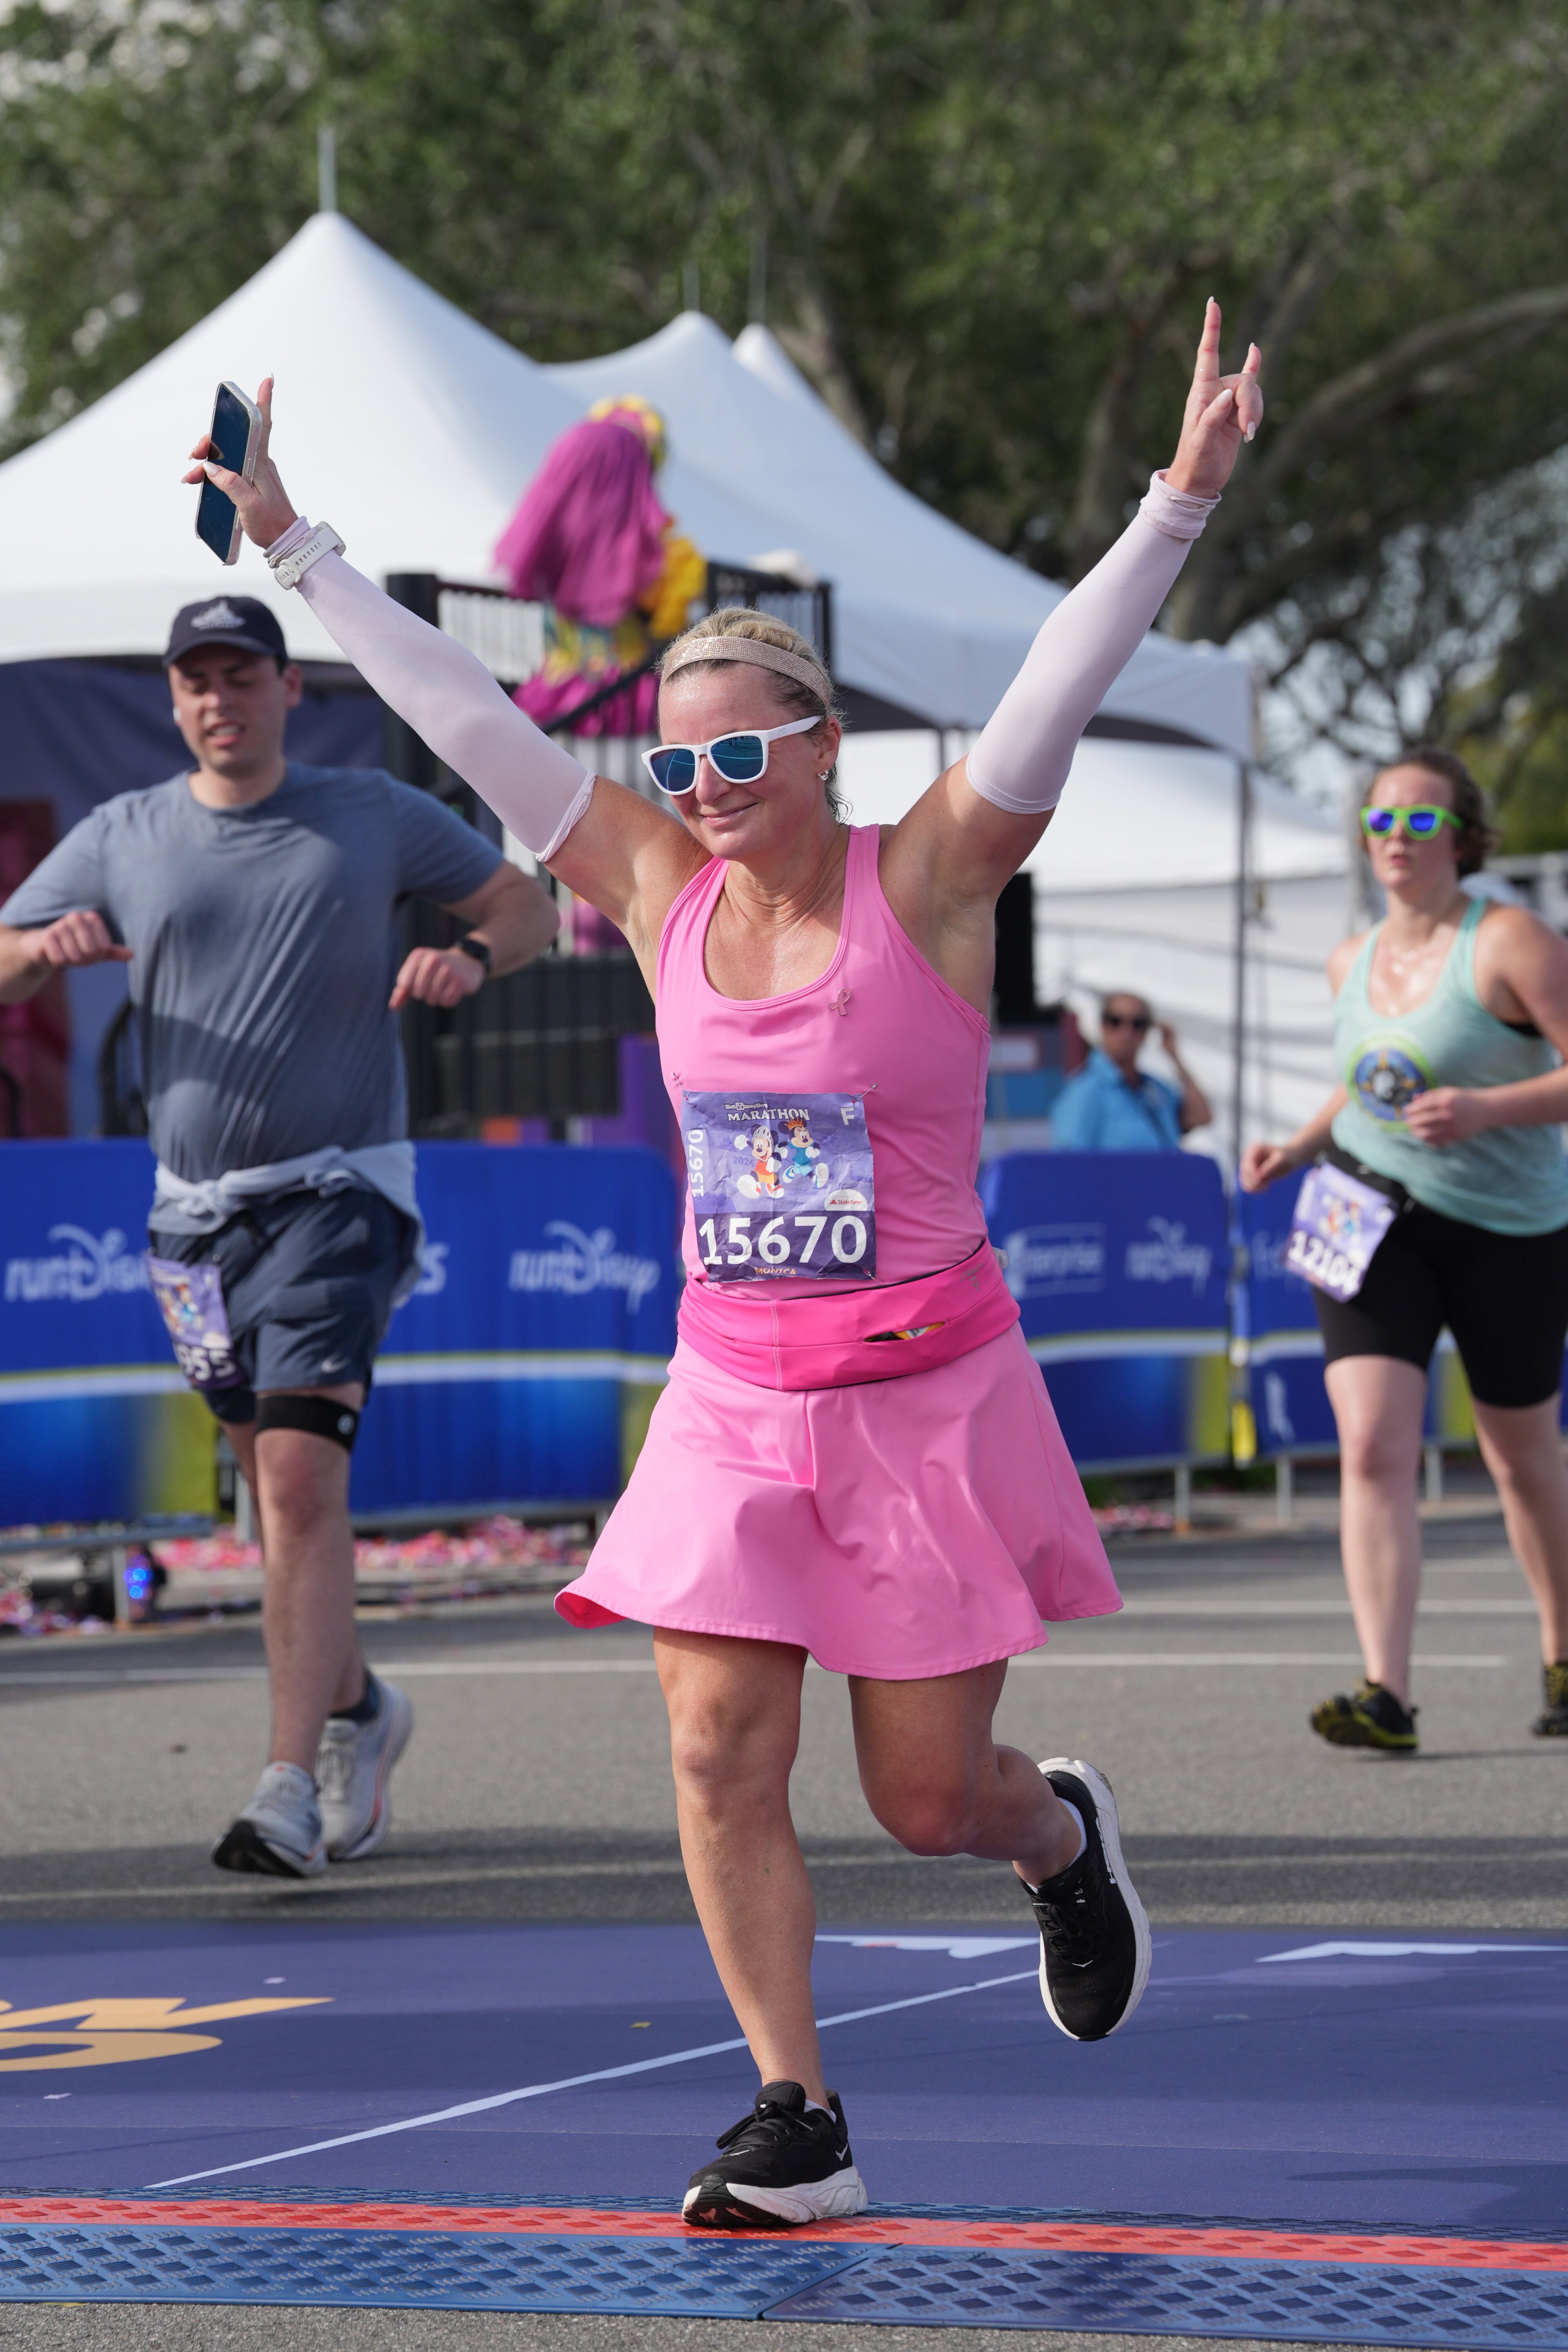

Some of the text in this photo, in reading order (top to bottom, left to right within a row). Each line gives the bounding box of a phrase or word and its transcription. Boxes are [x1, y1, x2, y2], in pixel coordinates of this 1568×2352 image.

[727, 1108, 811, 1122] MARATHON
[840, 1107, 855, 1125] F
[688, 1129, 704, 1197] 15670
[732, 1156, 755, 1167] 2026
[699, 1215, 867, 1265] 15670
[754, 1267, 796, 1275] MONICA
